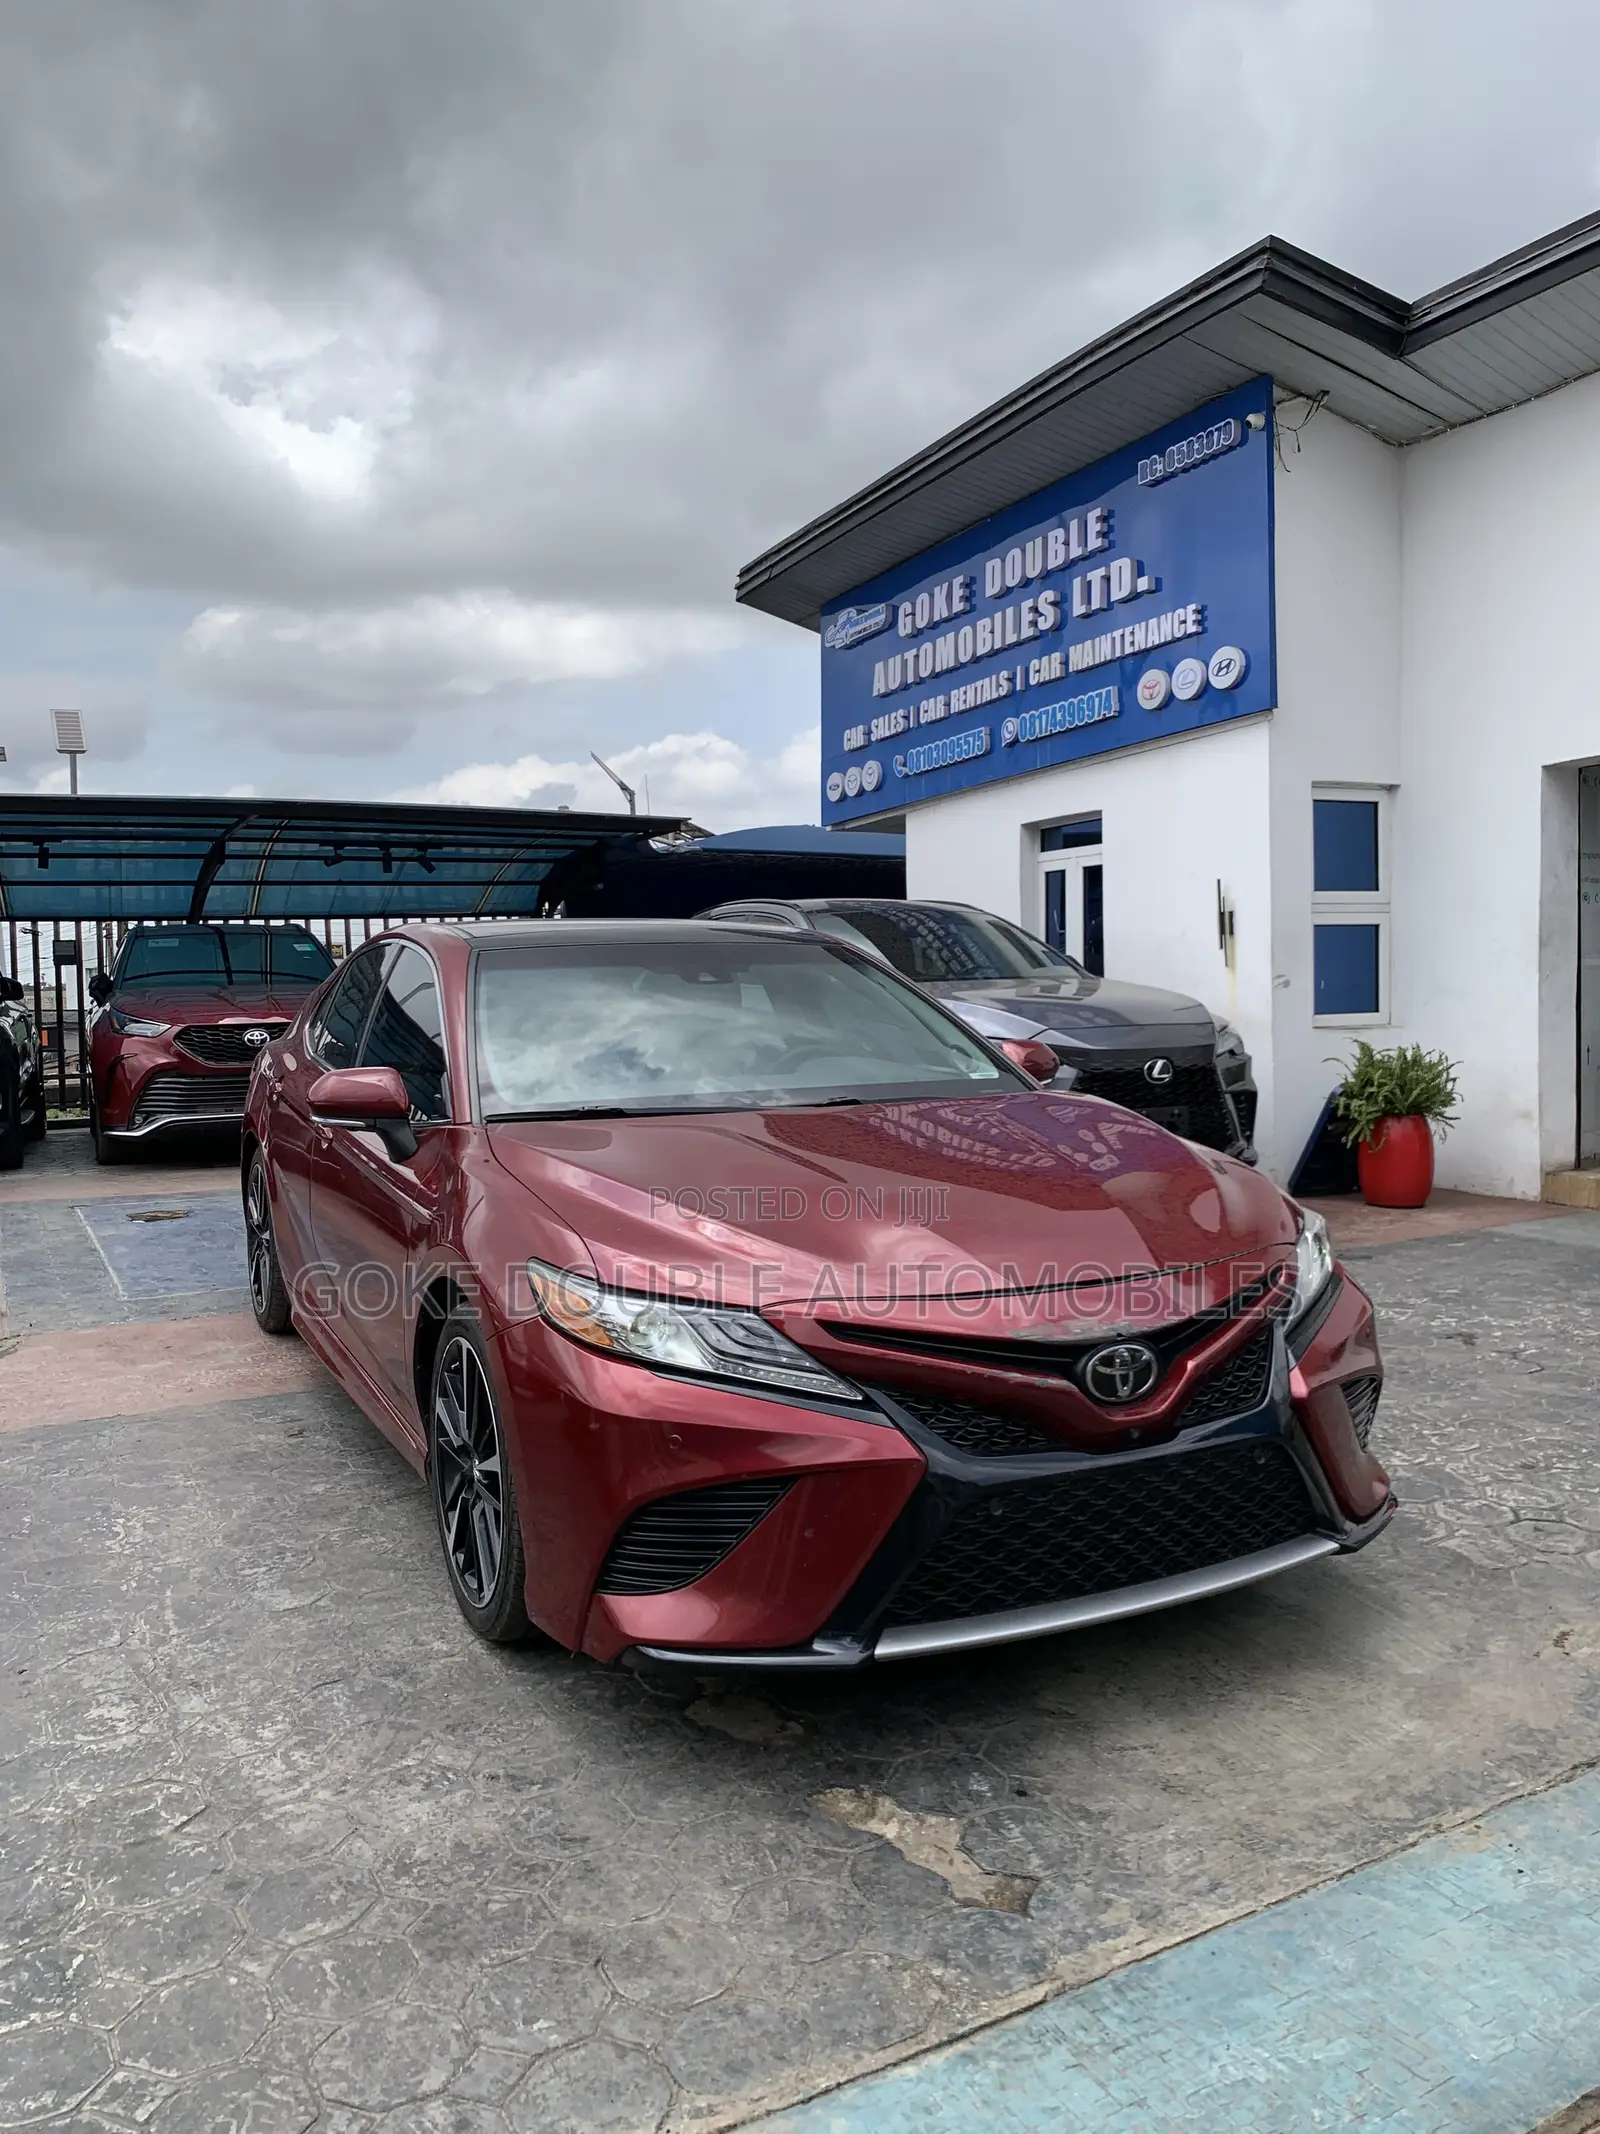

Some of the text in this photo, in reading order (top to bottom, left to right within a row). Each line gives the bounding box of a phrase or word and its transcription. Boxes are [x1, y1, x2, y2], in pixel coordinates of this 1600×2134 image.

[1138, 455, 1164, 485] RC:
[873, 557, 1156, 697] AUTOMOBILES LTD.
[898, 507, 1109, 637] GOKE DOUBLE
[843, 724, 868, 751] CAR
[871, 709, 908, 742] SALES
[919, 695, 949, 724] CAR
[950, 670, 1012, 713] RENTALS
[1029, 652, 1065, 686] CAR
[1069, 603, 1202, 672] MAINTENANCE
[907, 686, 1115, 775] 08103095575 08174396974
